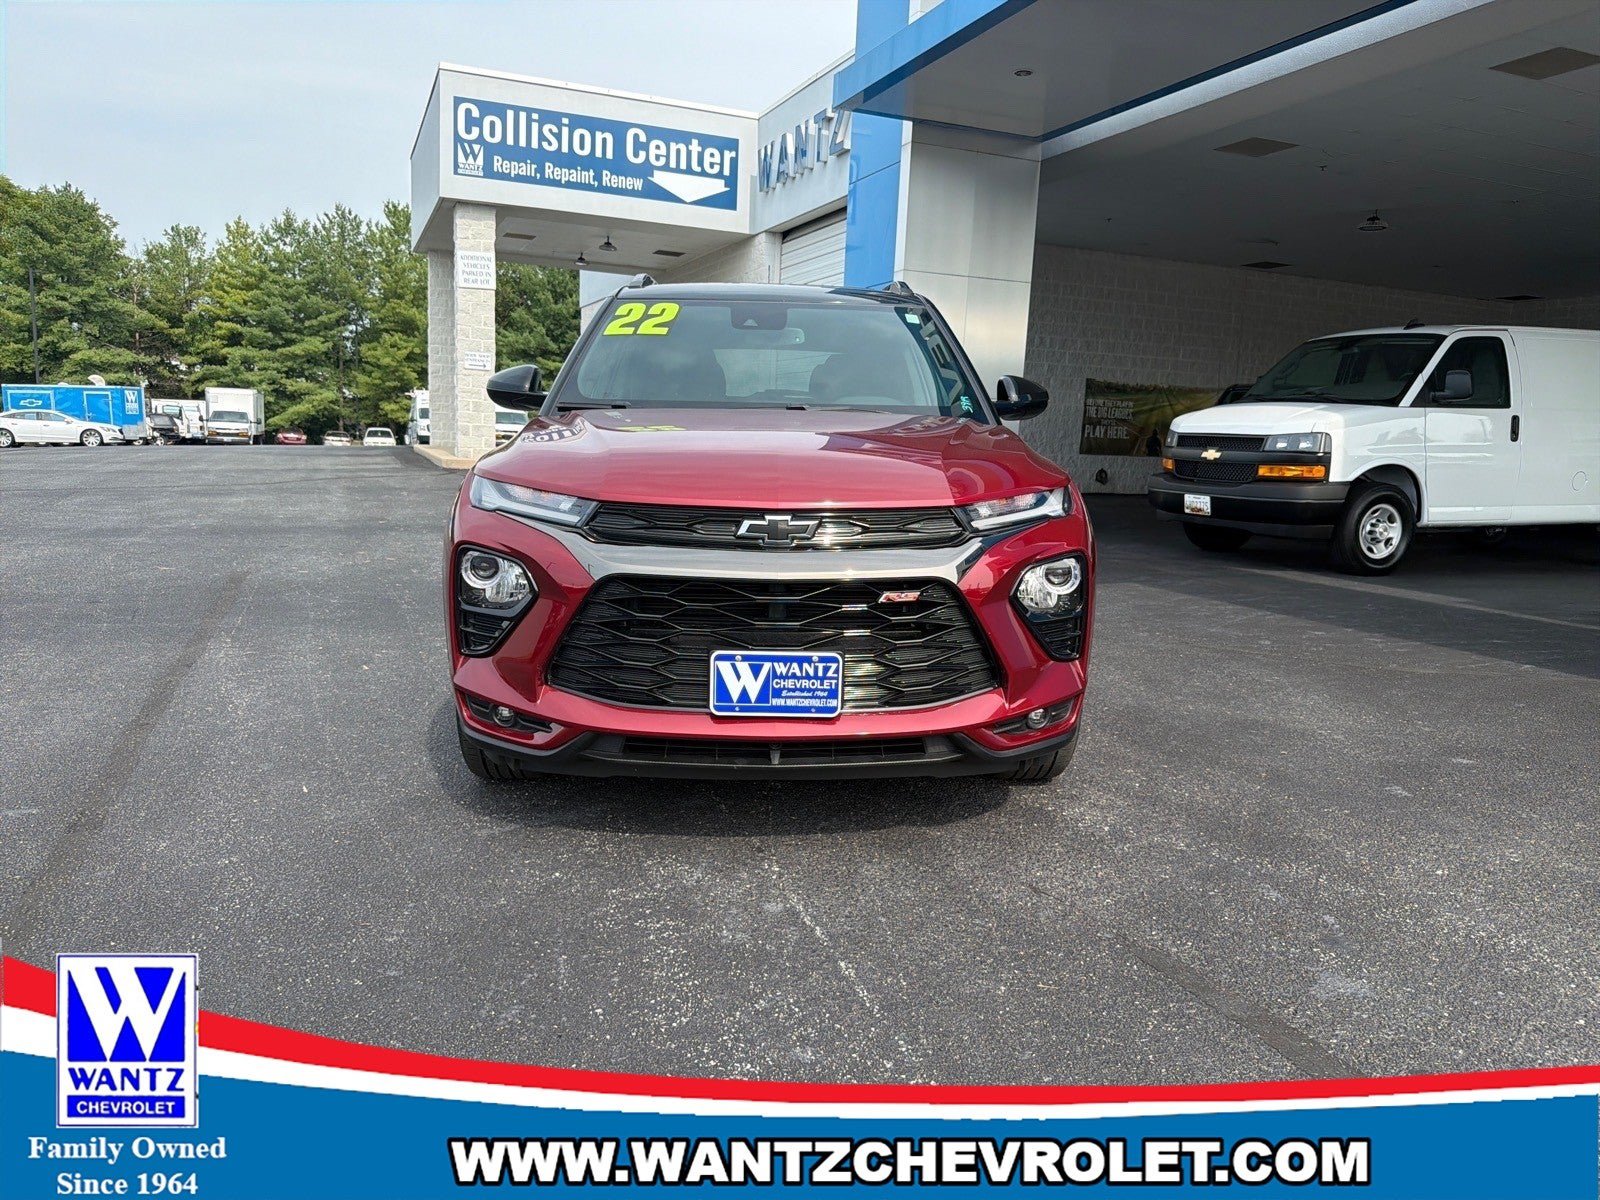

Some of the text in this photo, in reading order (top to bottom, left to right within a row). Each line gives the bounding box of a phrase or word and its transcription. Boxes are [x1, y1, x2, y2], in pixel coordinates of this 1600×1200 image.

[457, 102, 736, 176] Collision Center
[758, 108, 850, 192] WANTZ
[458, 162, 483, 171] WANTZ
[493, 155, 643, 191] Repair, Repaint, Renew
[463, 262, 490, 270] VEHICLES
[603, 302, 680, 336] 22
[1086, 406, 1097, 418] THE
[1085, 425, 1105, 438] PLAY
[878, 591, 921, 603] RS
[773, 662, 838, 677] WANTZ
[773, 679, 837, 689] CHEVROLET
[772, 698, 838, 707] WWW.WANTZCHEVROLET.COM
